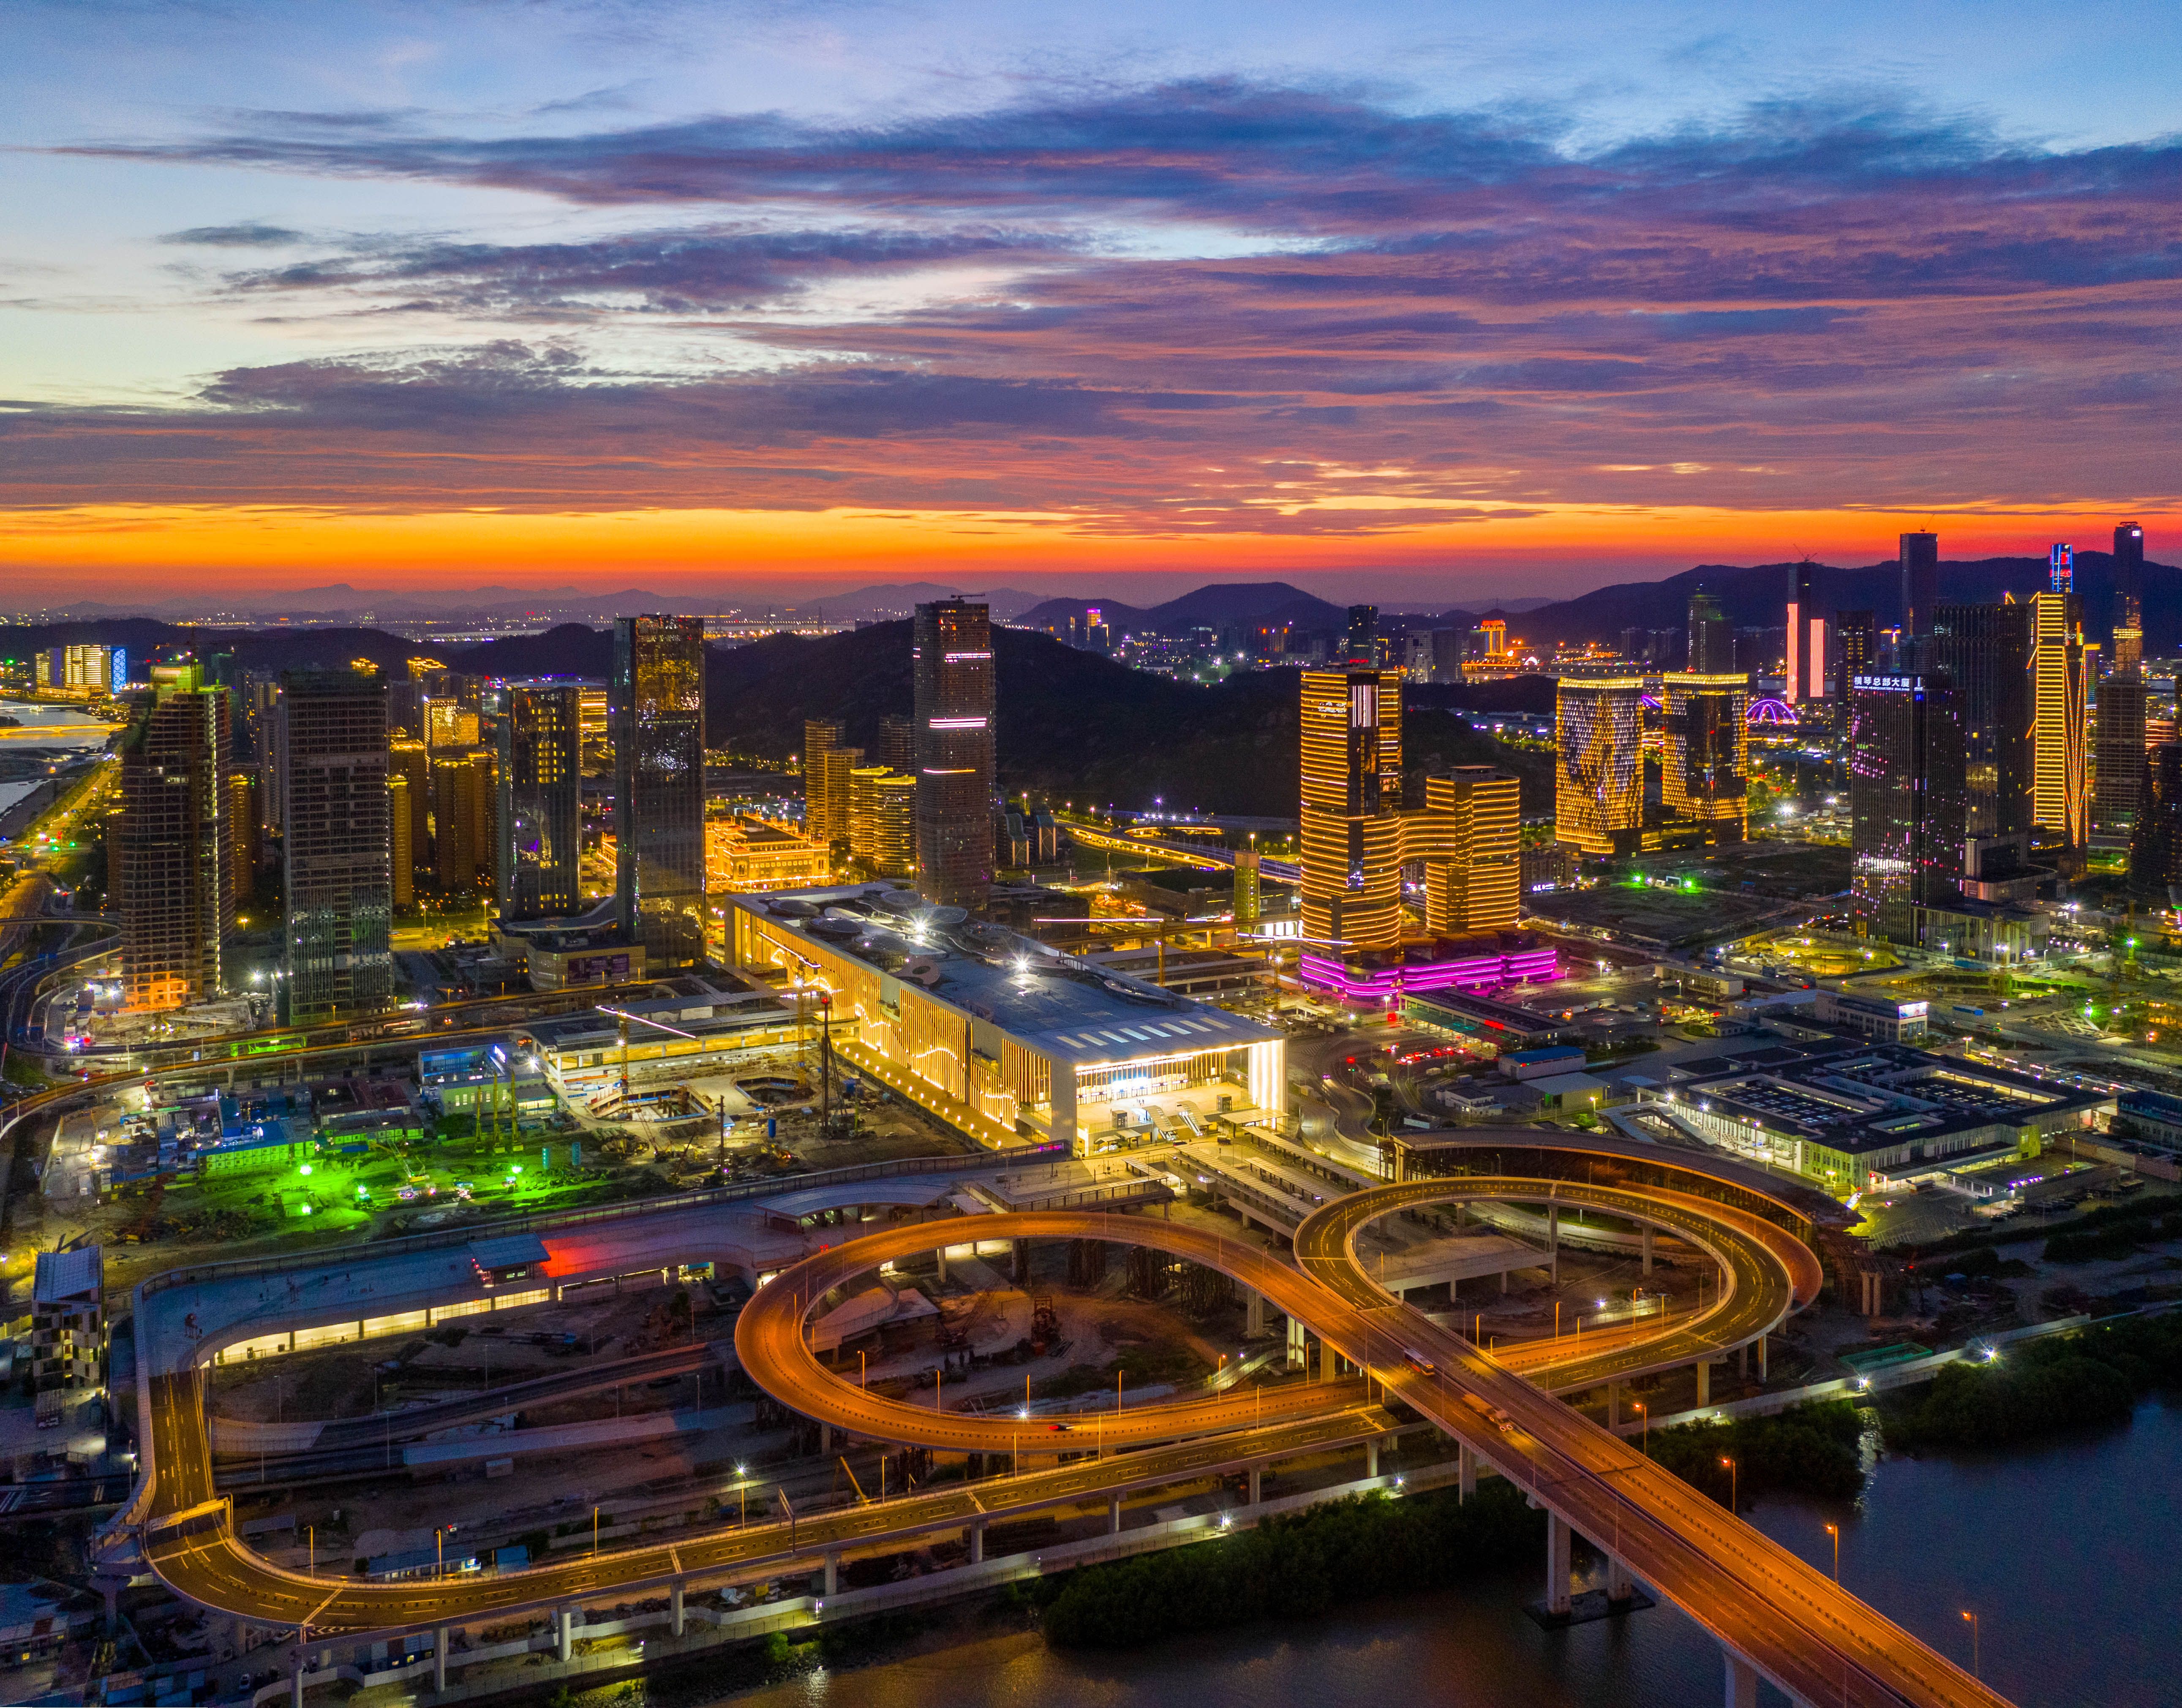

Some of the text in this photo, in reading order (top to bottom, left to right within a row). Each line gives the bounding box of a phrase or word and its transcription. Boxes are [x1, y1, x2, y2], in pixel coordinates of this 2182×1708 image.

[1854, 676, 1910, 688] 横琴总部大厦
